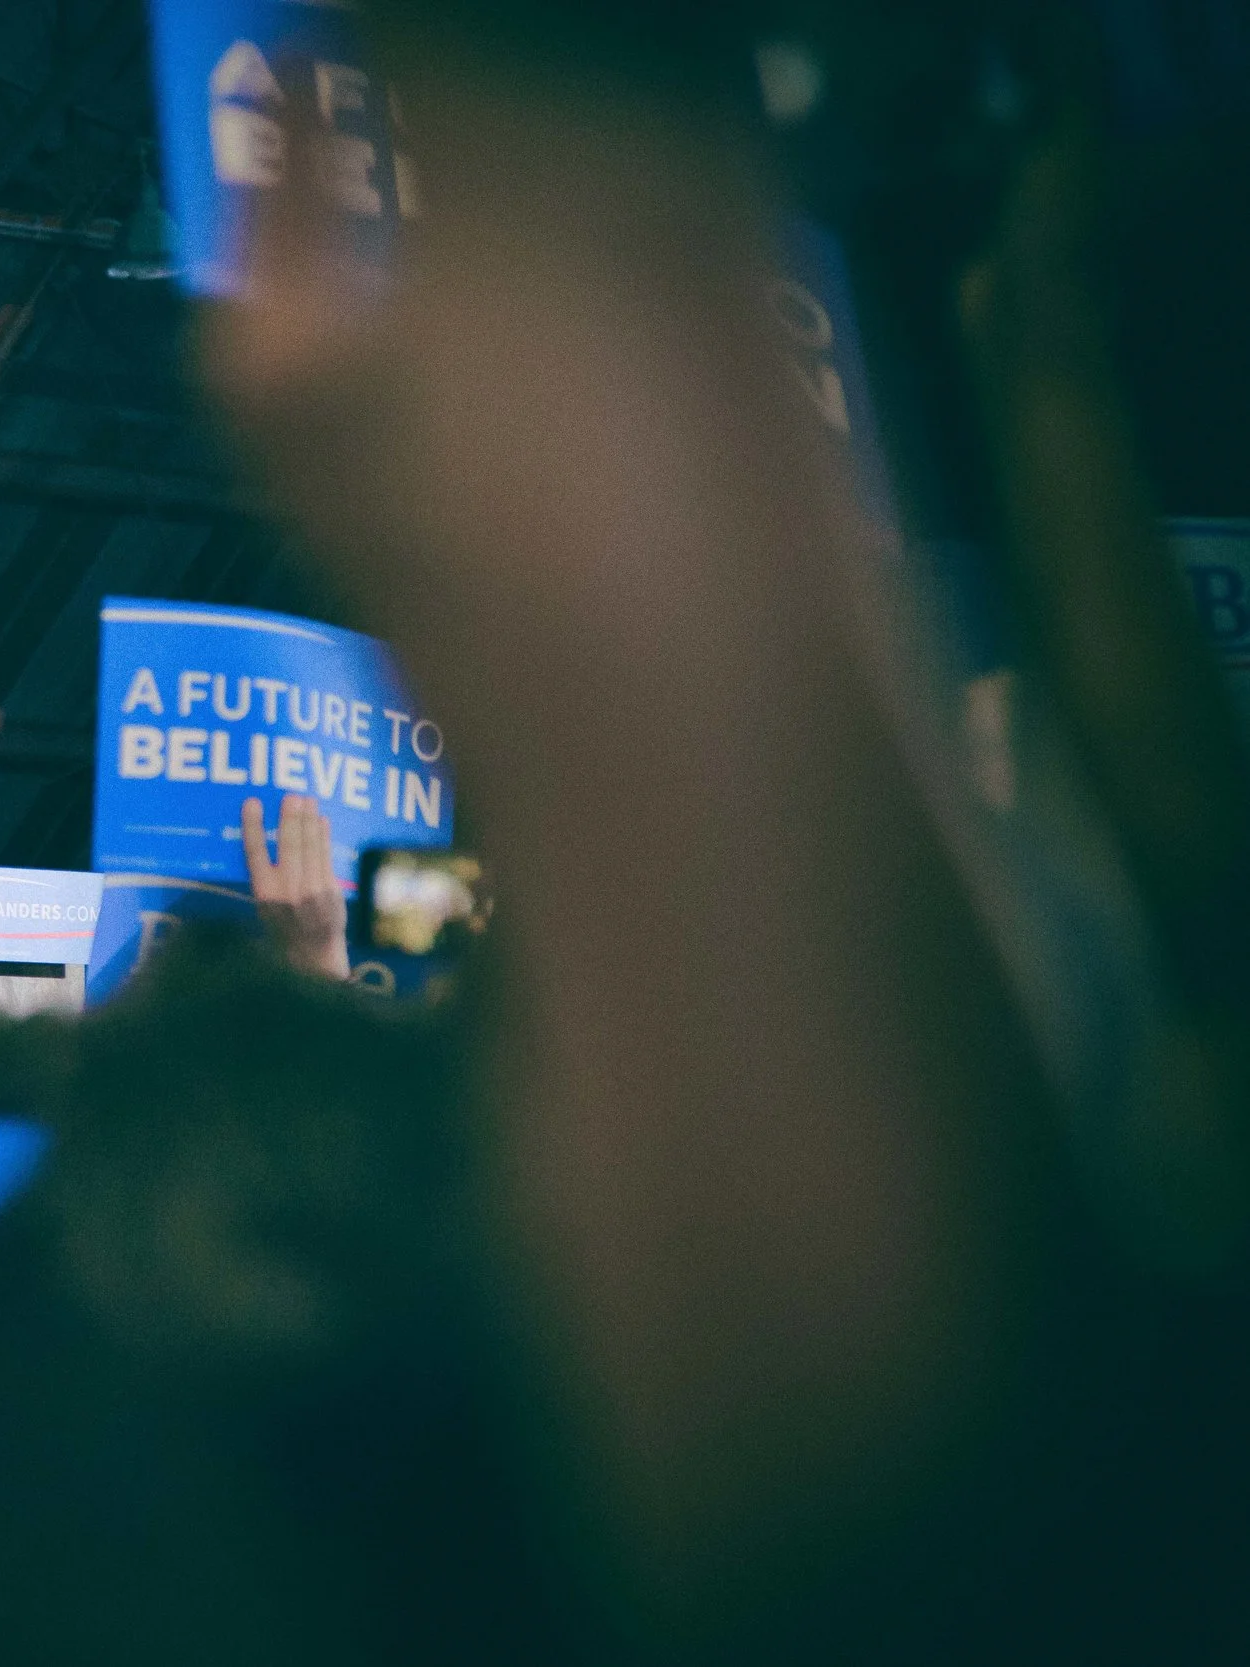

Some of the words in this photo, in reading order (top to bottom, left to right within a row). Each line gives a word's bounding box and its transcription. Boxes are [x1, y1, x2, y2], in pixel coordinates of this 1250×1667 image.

[122, 667, 164, 715] A
[178, 669, 373, 749] FUTURE
[384, 708, 445, 764] TO
[118, 723, 373, 812] BELIEVE
[384, 765, 442, 829] IN
